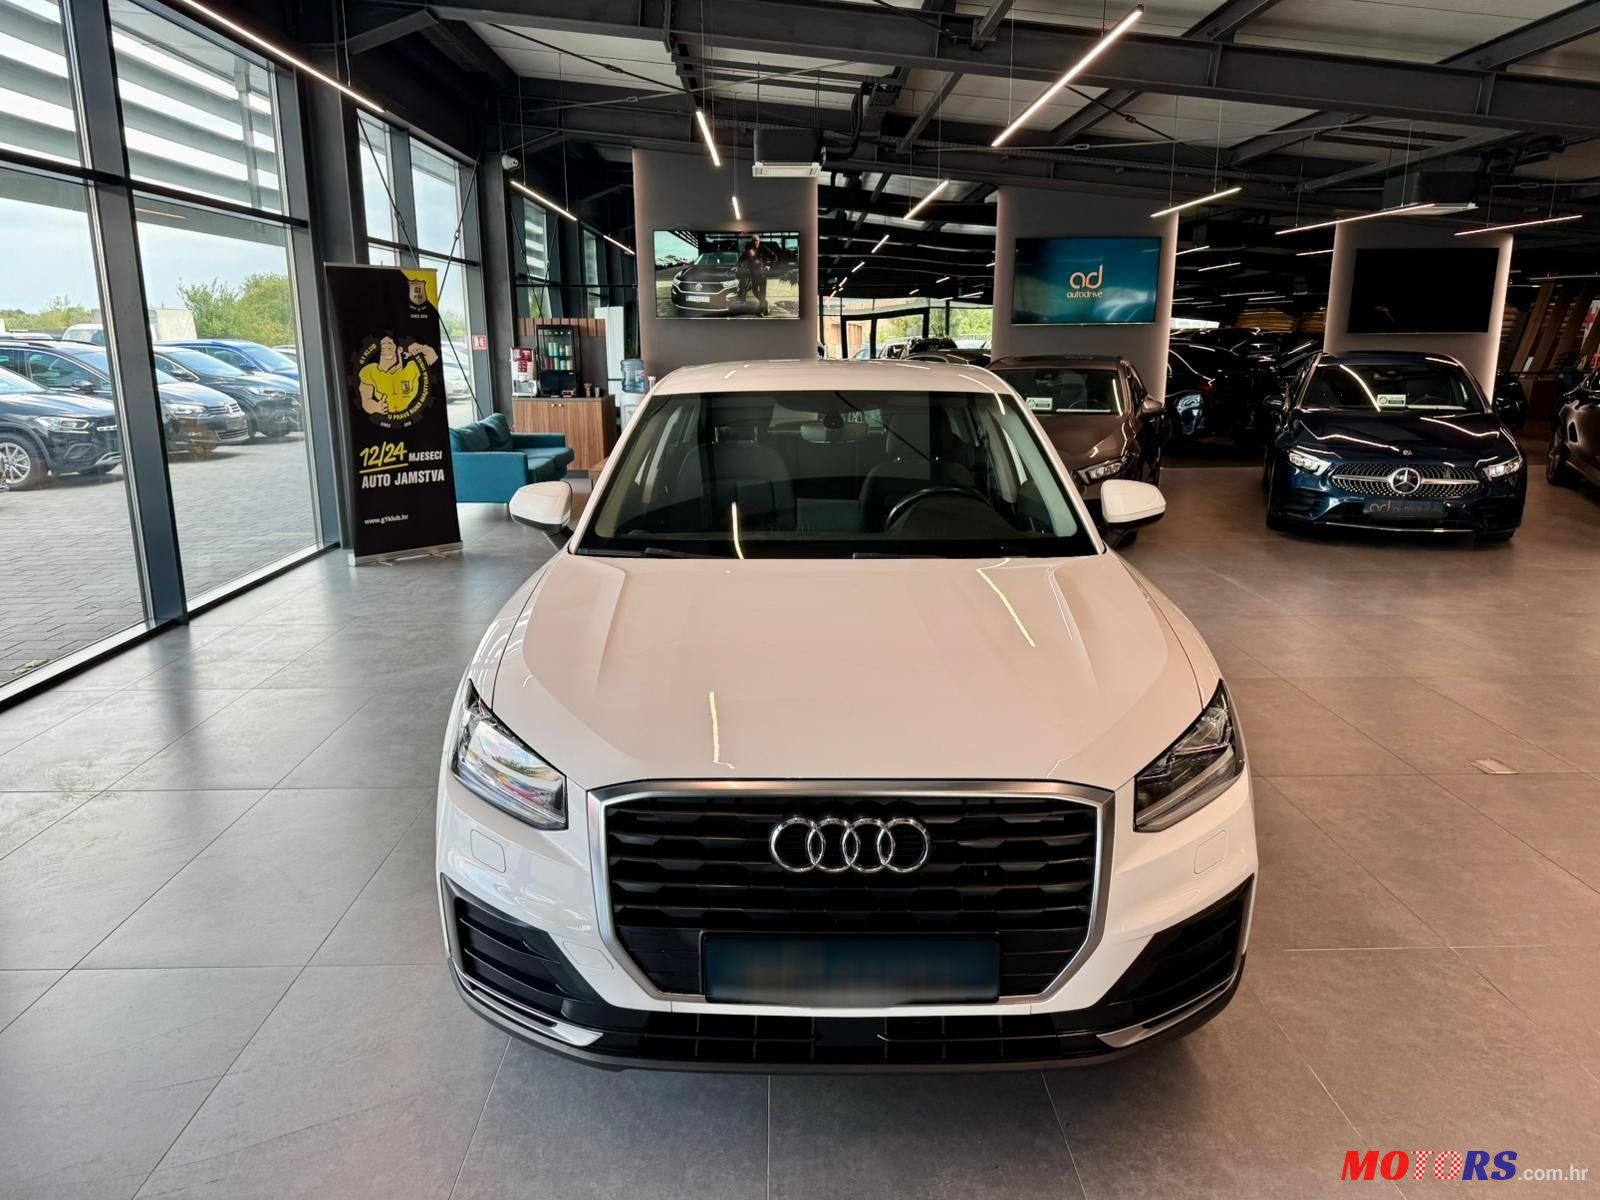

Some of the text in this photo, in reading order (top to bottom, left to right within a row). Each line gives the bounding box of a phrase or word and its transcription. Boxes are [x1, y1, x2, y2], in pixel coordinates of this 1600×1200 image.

[1069, 264, 1104, 289] ad
[1066, 290, 1103, 299] autodrive
[360, 441, 442, 467] 12/24 MJESECI
[361, 468, 445, 489] AUTO JAMSTVA
